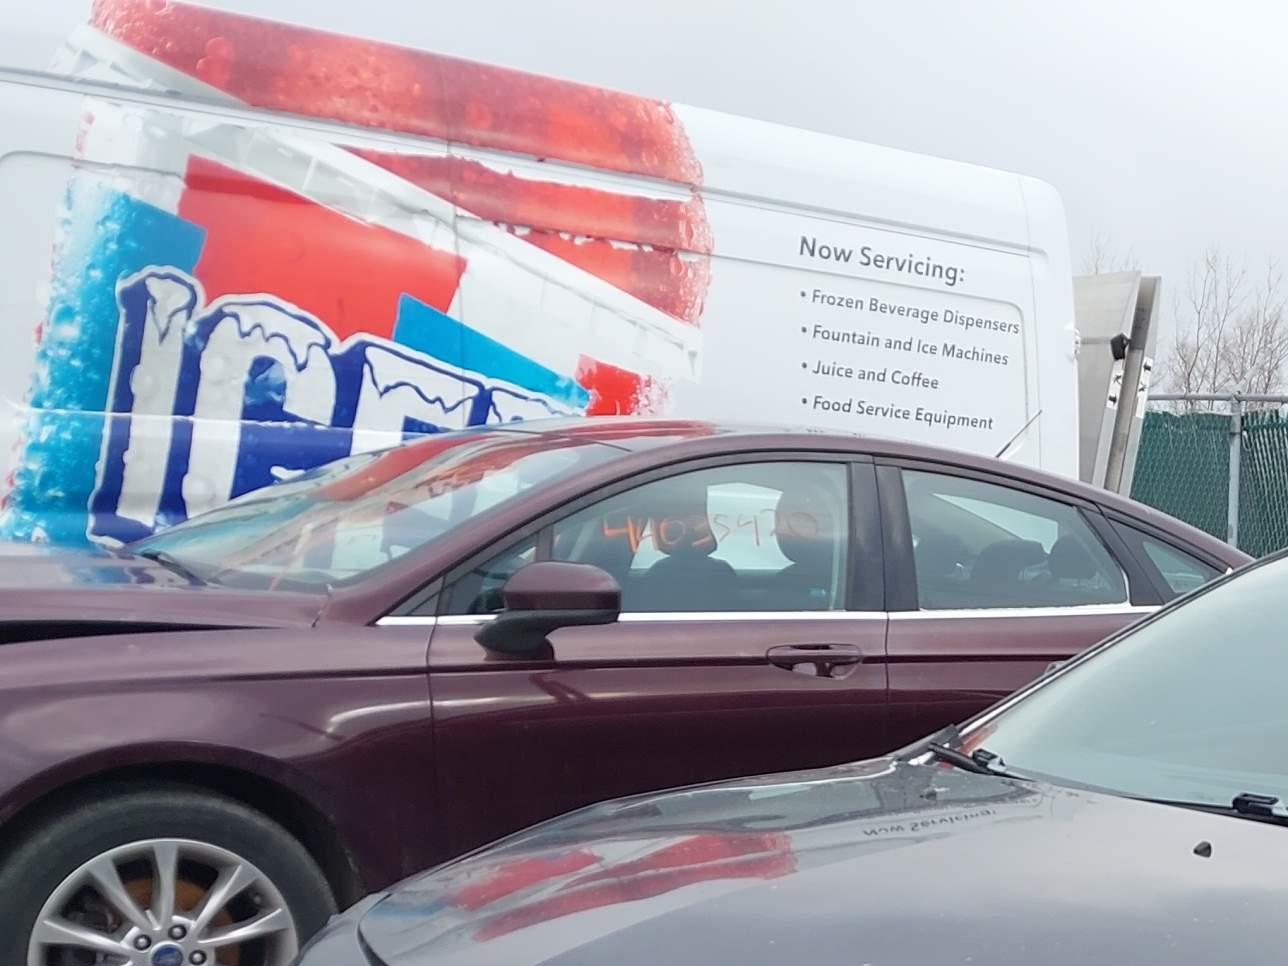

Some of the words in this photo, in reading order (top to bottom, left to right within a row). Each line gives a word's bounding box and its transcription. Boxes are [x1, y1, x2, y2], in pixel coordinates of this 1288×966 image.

[800, 236, 852, 262] Now
[860, 246, 965, 286] Servicing:
[812, 289, 864, 311] Frozen
[869, 297, 939, 324] Beverage
[943, 309, 1020, 335] Dispensers
[813, 325, 880, 348] Fountain
[884, 336, 912, 352] and
[917, 339, 938, 355] Ice
[942, 343, 1009, 366] Machines
[812, 360, 853, 379] Juice
[857, 366, 886, 383] and
[891, 370, 940, 390] Coffee
[813, 395, 852, 413] Food
[856, 400, 910, 421] Service
[915, 408, 993, 430] Equipment
